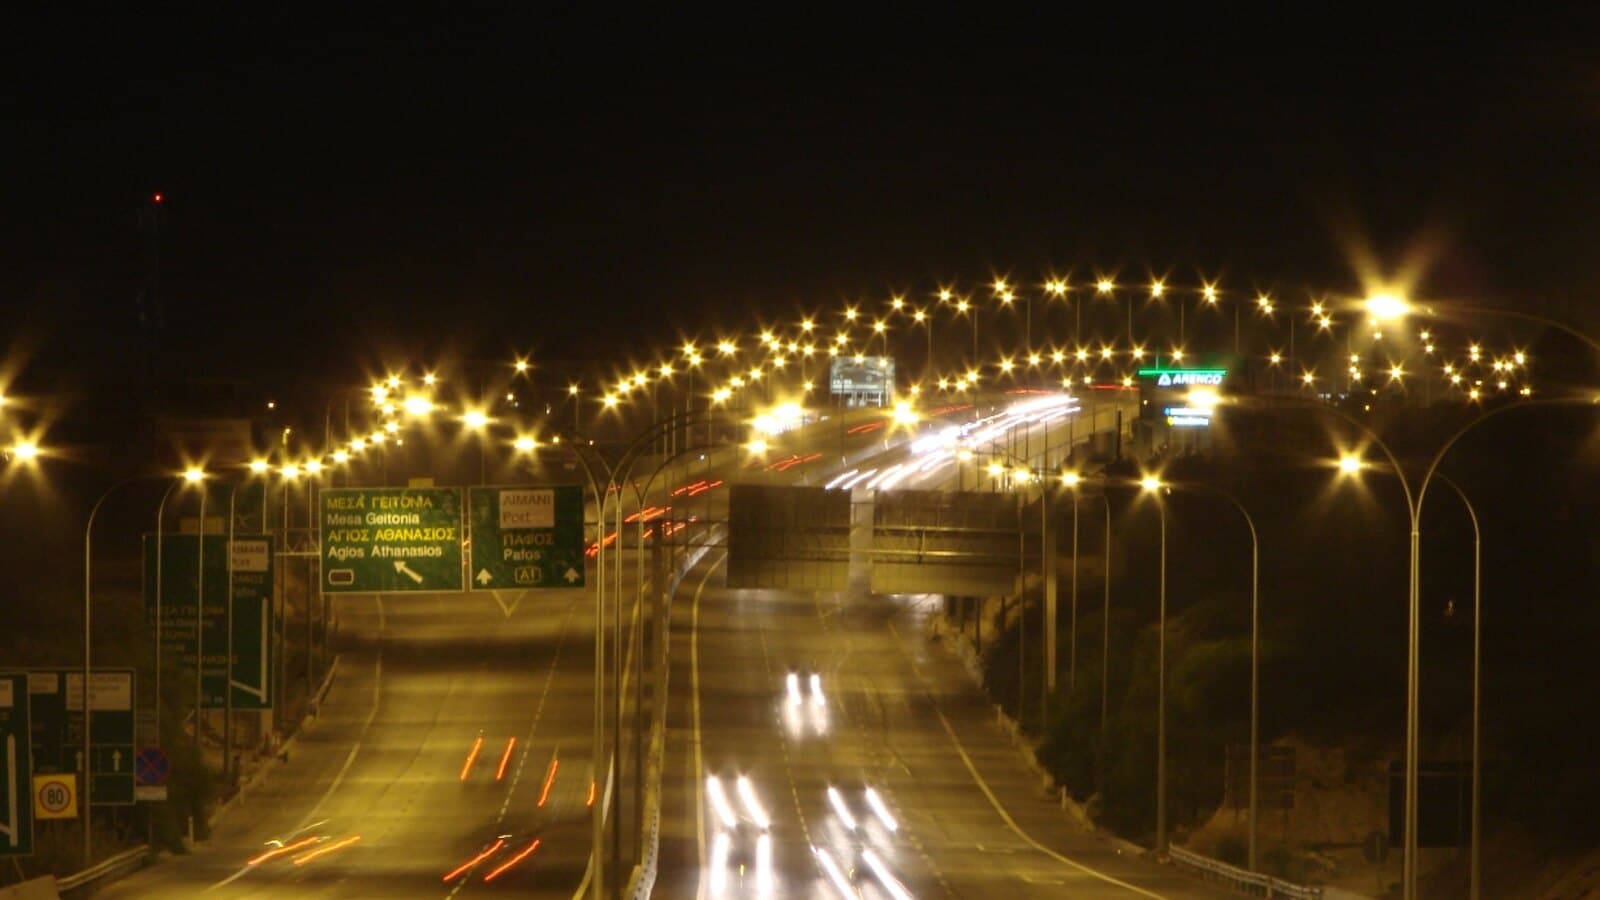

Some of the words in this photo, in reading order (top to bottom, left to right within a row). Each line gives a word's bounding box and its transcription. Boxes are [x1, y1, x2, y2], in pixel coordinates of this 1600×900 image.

[327, 513, 362, 525] Mesa
[365, 511, 420, 525] Geitonia
[503, 511, 530, 523] Port
[328, 529, 369, 542] ΑΓΙΟΣ
[374, 527, 456, 542] ΑΘΑΝΑΣΙΟΣ
[503, 533, 555, 545] ΠΑΦΟΣ
[327, 545, 365, 561] Agios
[370, 544, 443, 558] Athanasios
[503, 548, 541, 561] Pafos
[47, 789, 64, 805] 80
